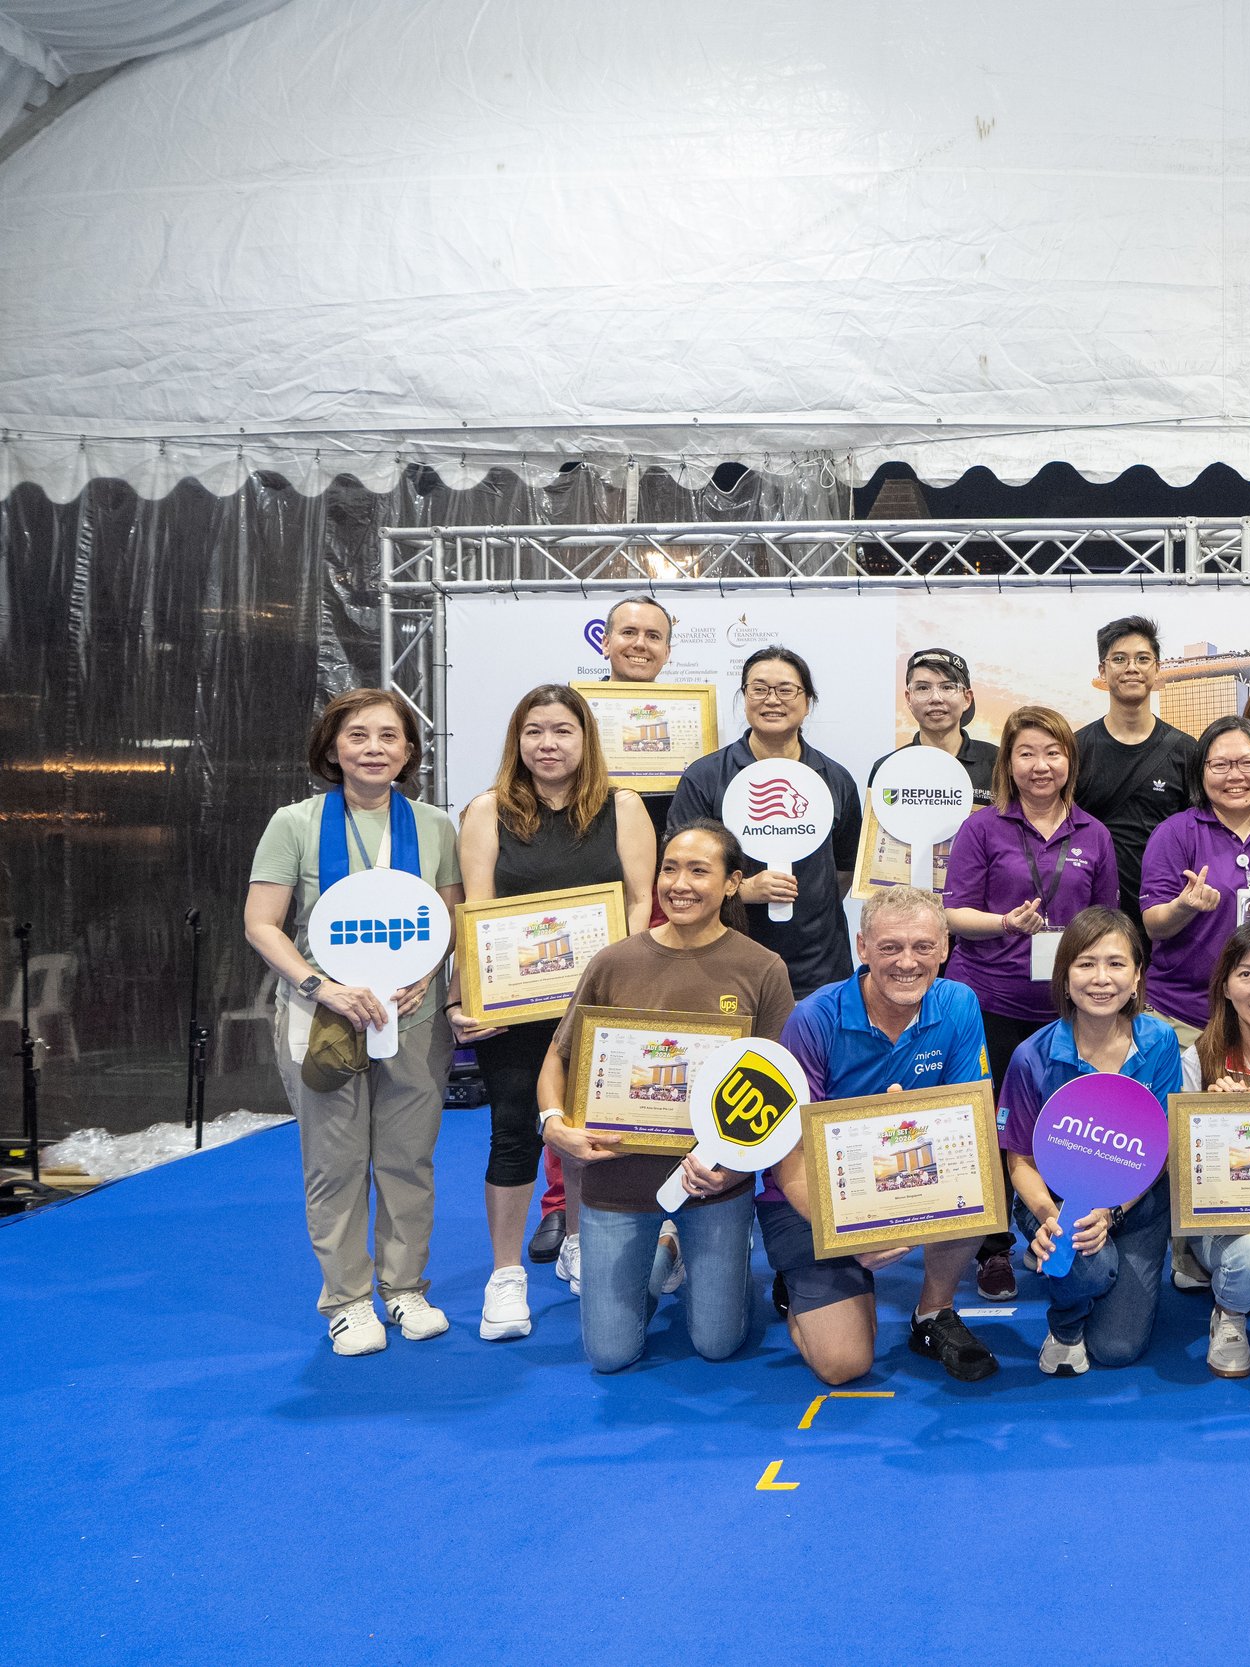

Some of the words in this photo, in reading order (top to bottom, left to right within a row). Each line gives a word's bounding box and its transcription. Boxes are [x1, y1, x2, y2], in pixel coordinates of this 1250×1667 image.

[577, 666, 610, 675] Blossom
[902, 787, 962, 799] REPUBLIC
[742, 824, 816, 836] AmChamSG
[722, 1000, 736, 1012] ups
[722, 1070, 779, 1135] ups
[1052, 1116, 1146, 1156] micron
[1048, 1134, 1093, 1155] Intelligence
